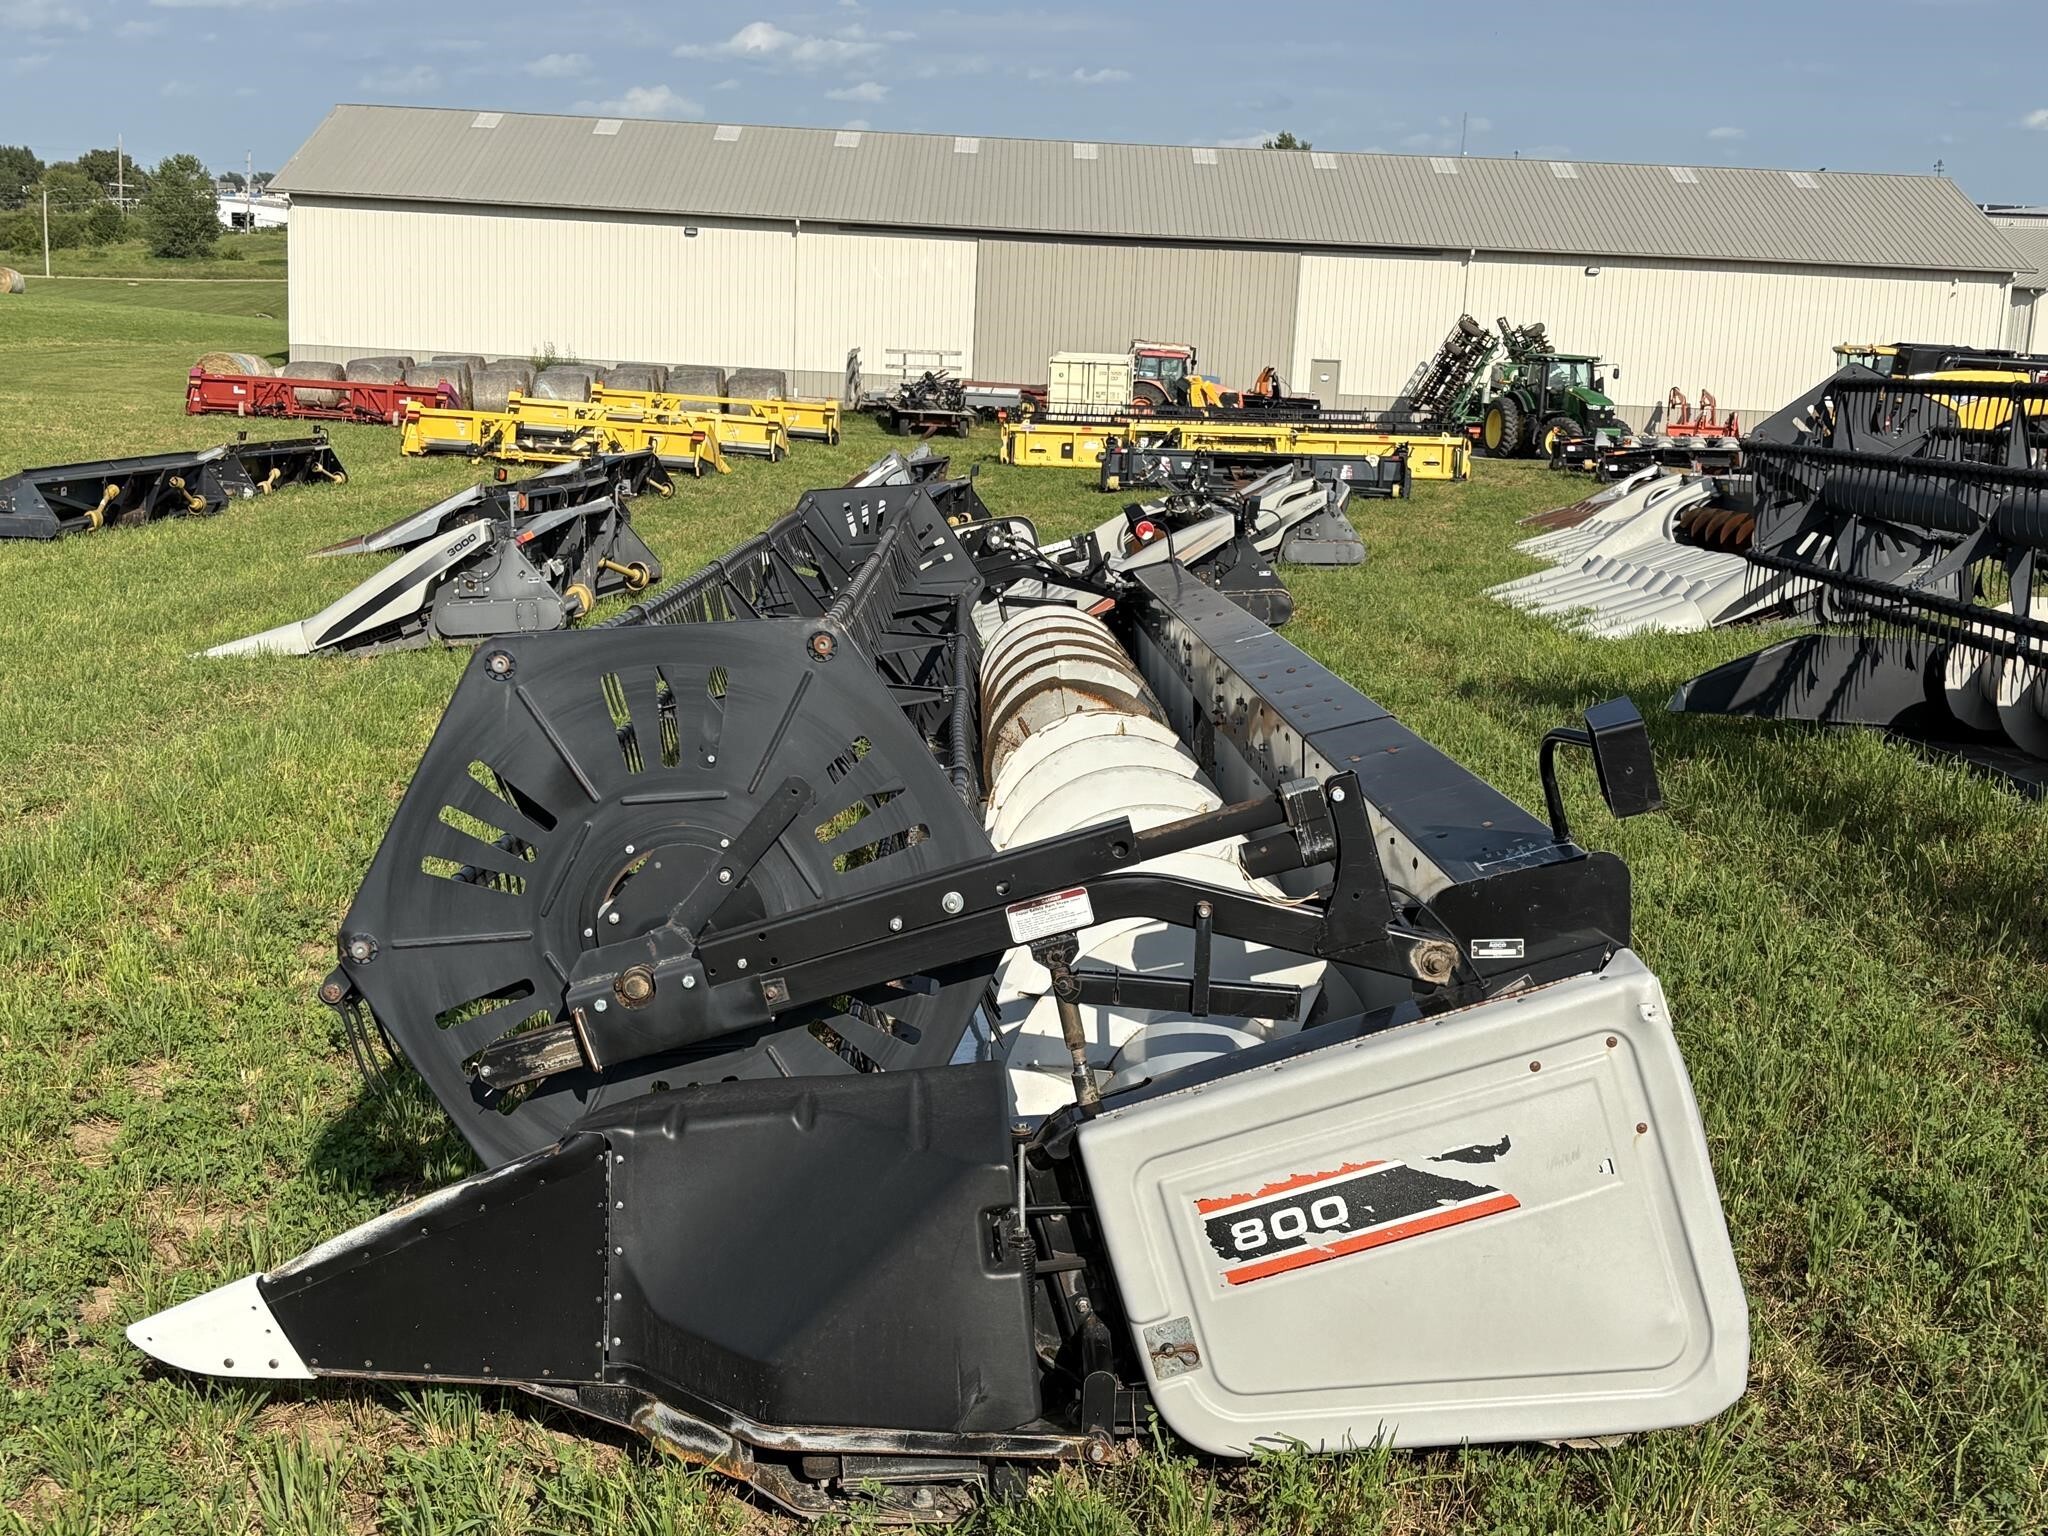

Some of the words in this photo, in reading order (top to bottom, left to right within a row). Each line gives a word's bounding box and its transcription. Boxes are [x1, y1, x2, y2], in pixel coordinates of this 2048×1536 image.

[447, 533, 477, 557] 3000
[1041, 895, 1062, 904] DANGER
[1231, 1196, 1348, 1251] 800
